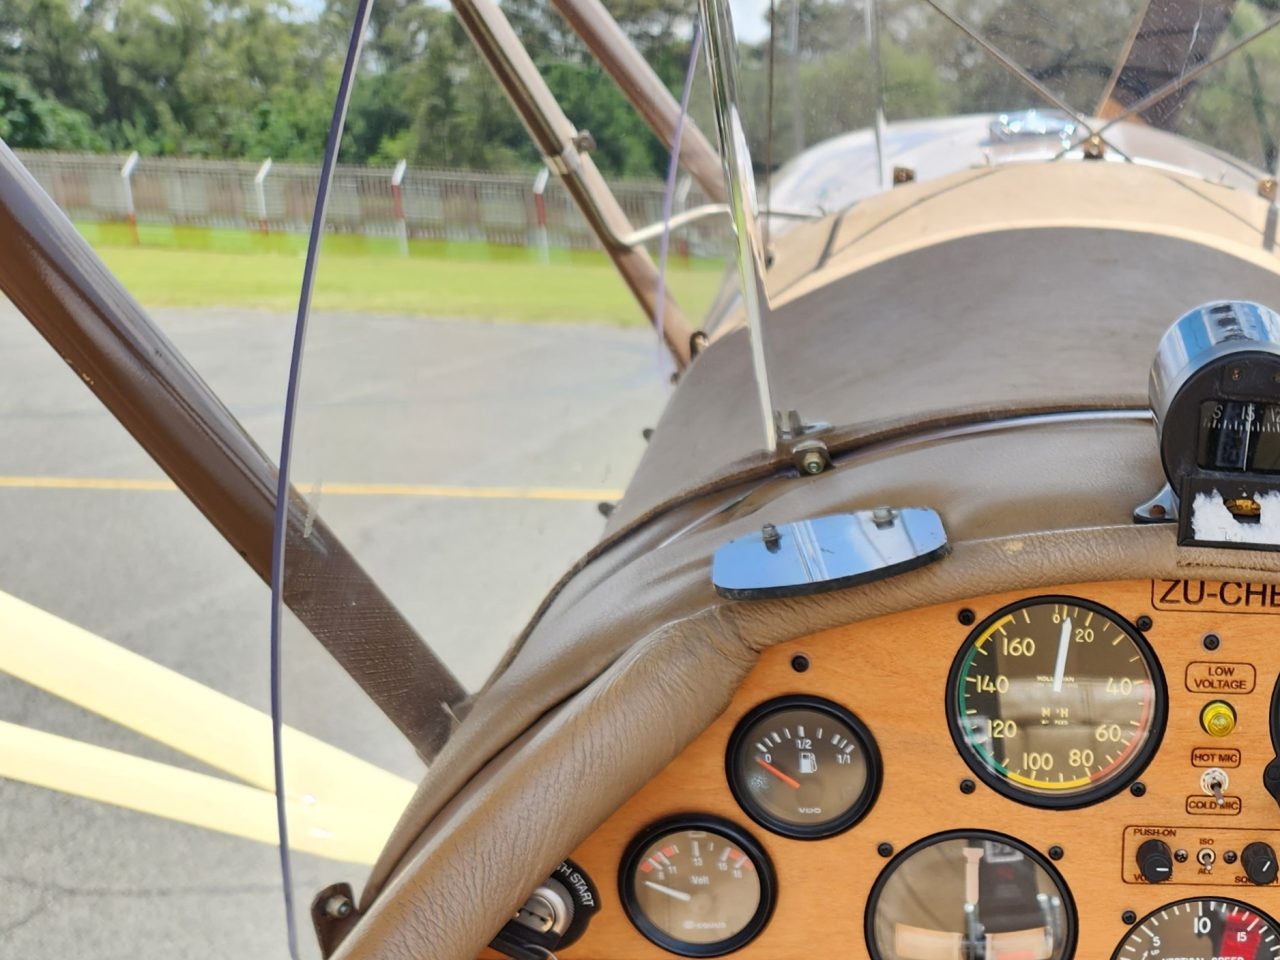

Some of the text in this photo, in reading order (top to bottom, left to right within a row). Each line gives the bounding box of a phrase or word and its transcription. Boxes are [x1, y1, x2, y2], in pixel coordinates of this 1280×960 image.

[1213, 406, 1222, 418] S
[1052, 613, 1060, 624] 0
[1075, 628, 1094, 643] 20
[1003, 638, 1036, 656] 160
[1208, 666, 1235, 677] LOW
[976, 675, 1009, 694] 140
[1106, 678, 1132, 696] 40
[1194, 679, 1248, 690] VOLTAGE
[988, 720, 1018, 738] 120
[1095, 724, 1122, 742] 60
[796, 738, 812, 750] 1/2
[764, 754, 772, 764] 0
[836, 754, 851, 764] 1/1
[1022, 752, 1054, 771] 100
[1069, 749, 1094, 767] 80
[1194, 754, 1238, 763] HOT MIC
[1188, 800, 1239, 810] COLD MIC
[1133, 828, 1177, 837] PUSH-ON
[1199, 838, 1214, 846] ISO
[691, 876, 709, 884] Volt
[570, 873, 595, 907] START
[1194, 917, 1211, 934] 10
[1153, 936, 1160, 947] 5
[1236, 932, 1248, 942] 15
